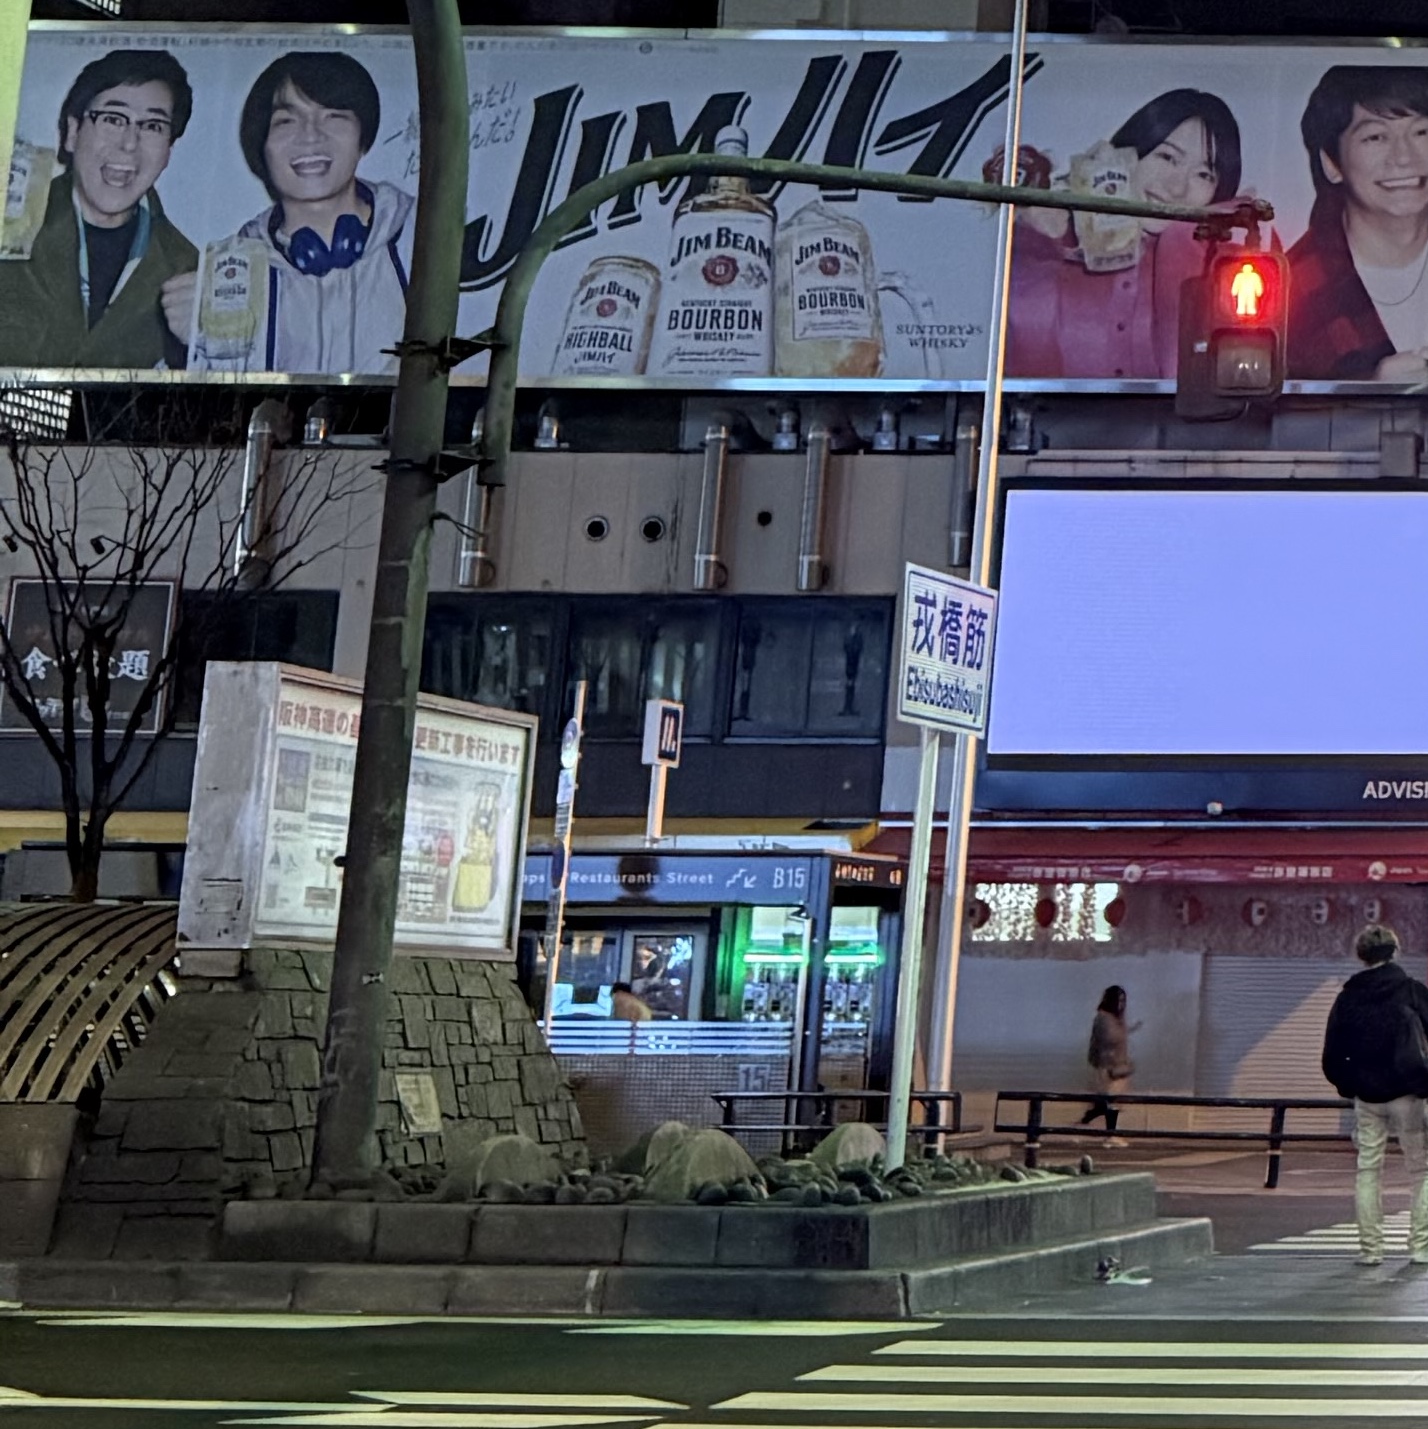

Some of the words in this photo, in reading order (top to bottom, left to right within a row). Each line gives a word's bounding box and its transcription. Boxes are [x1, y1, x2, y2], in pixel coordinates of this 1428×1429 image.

[670, 231, 712, 267] JIM
[714, 225, 773, 265] BEAM
[797, 290, 866, 312] BOURBON
[667, 308, 764, 332] BOURBON
[911, 588, 988, 671] 戎橋筋
[570, 872, 660, 886] Restaurants
[667, 873, 714, 885] Street
[773, 868, 806, 889] B15
